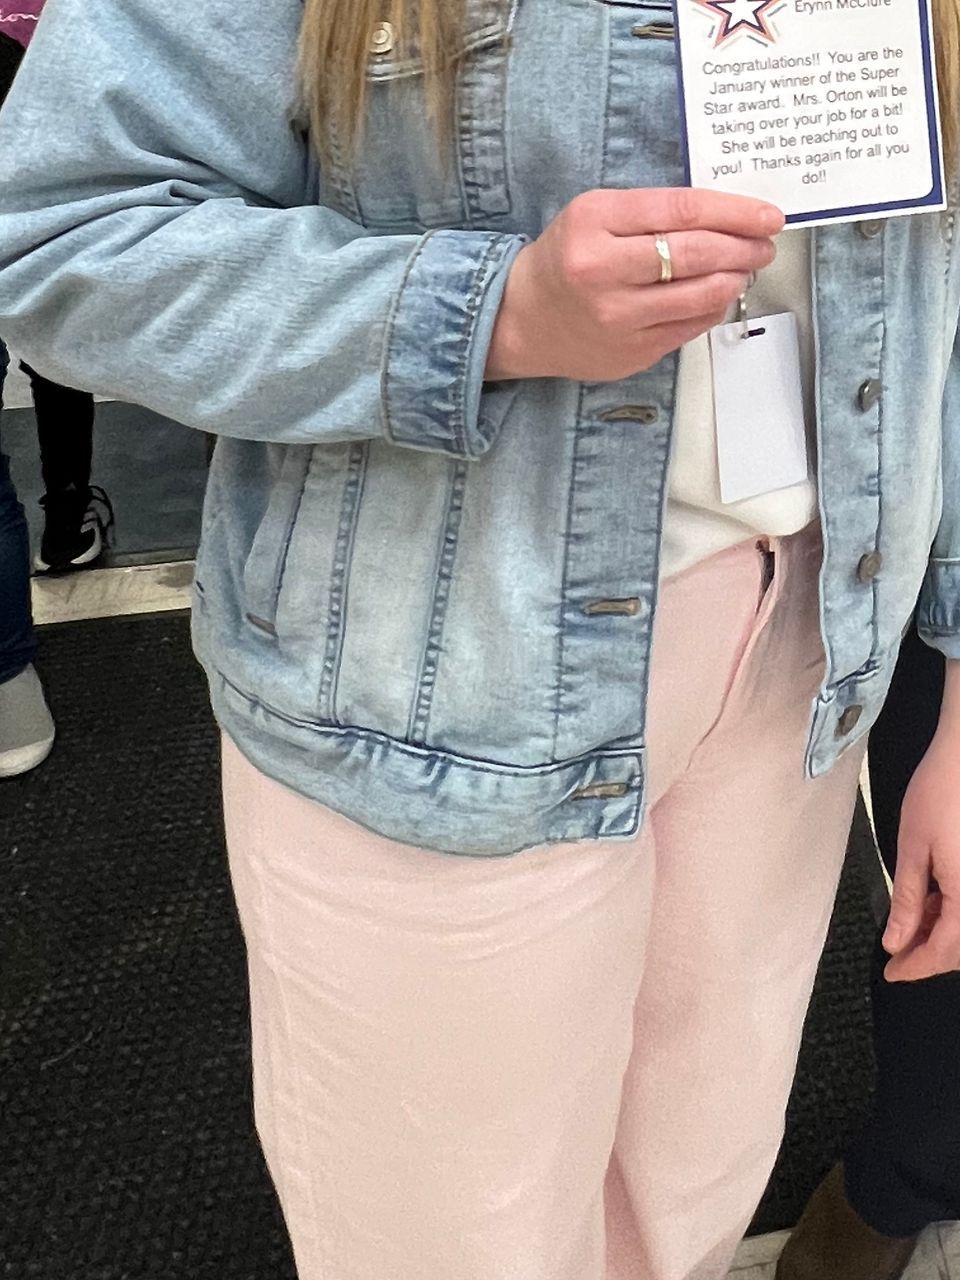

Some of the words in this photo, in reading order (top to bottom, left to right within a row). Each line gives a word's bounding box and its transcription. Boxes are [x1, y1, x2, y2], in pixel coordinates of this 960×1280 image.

[794, 0, 832, 15] Erynn
[702, 53, 820, 75] Congratulations!!
[828, 51, 853, 64] You
[857, 51, 878, 62] are
[883, 47, 904, 59] the
[710, 79, 766, 95] January
[770, 75, 815, 89] winner
[819, 71, 832, 84] of
[836, 70, 856, 82] the
[861, 67, 900, 82] Super
[704, 102, 733, 116] Star
[738, 96, 785, 112] award.
[793, 93, 822, 107] Mrs.
[826, 89, 863, 103] Orton
[867, 85, 888, 98] will
[891, 84, 908, 96] be
[711, 119, 755, 135] taking
[759, 117, 789, 130] over
[793, 113, 823, 129] your
[827, 110, 847, 126] job
[850, 107, 867, 120] for
[871, 108, 880, 118] a
[883, 102, 904, 117] bit!
[721, 140, 750, 154] She
[753, 136, 775, 150] will
[780, 135, 797, 148] be
[801, 128, 857, 145] reaching
[861, 125, 882, 139] out
[886, 124, 899, 136] to
[711, 160, 743, 179] you!
[752, 155, 801, 171] Thanks
[805, 150, 841, 167] again
[845, 146, 863, 160] for
[866, 144, 882, 158] all
[886, 142, 910, 158] you
[802, 170, 827, 185] do!!
